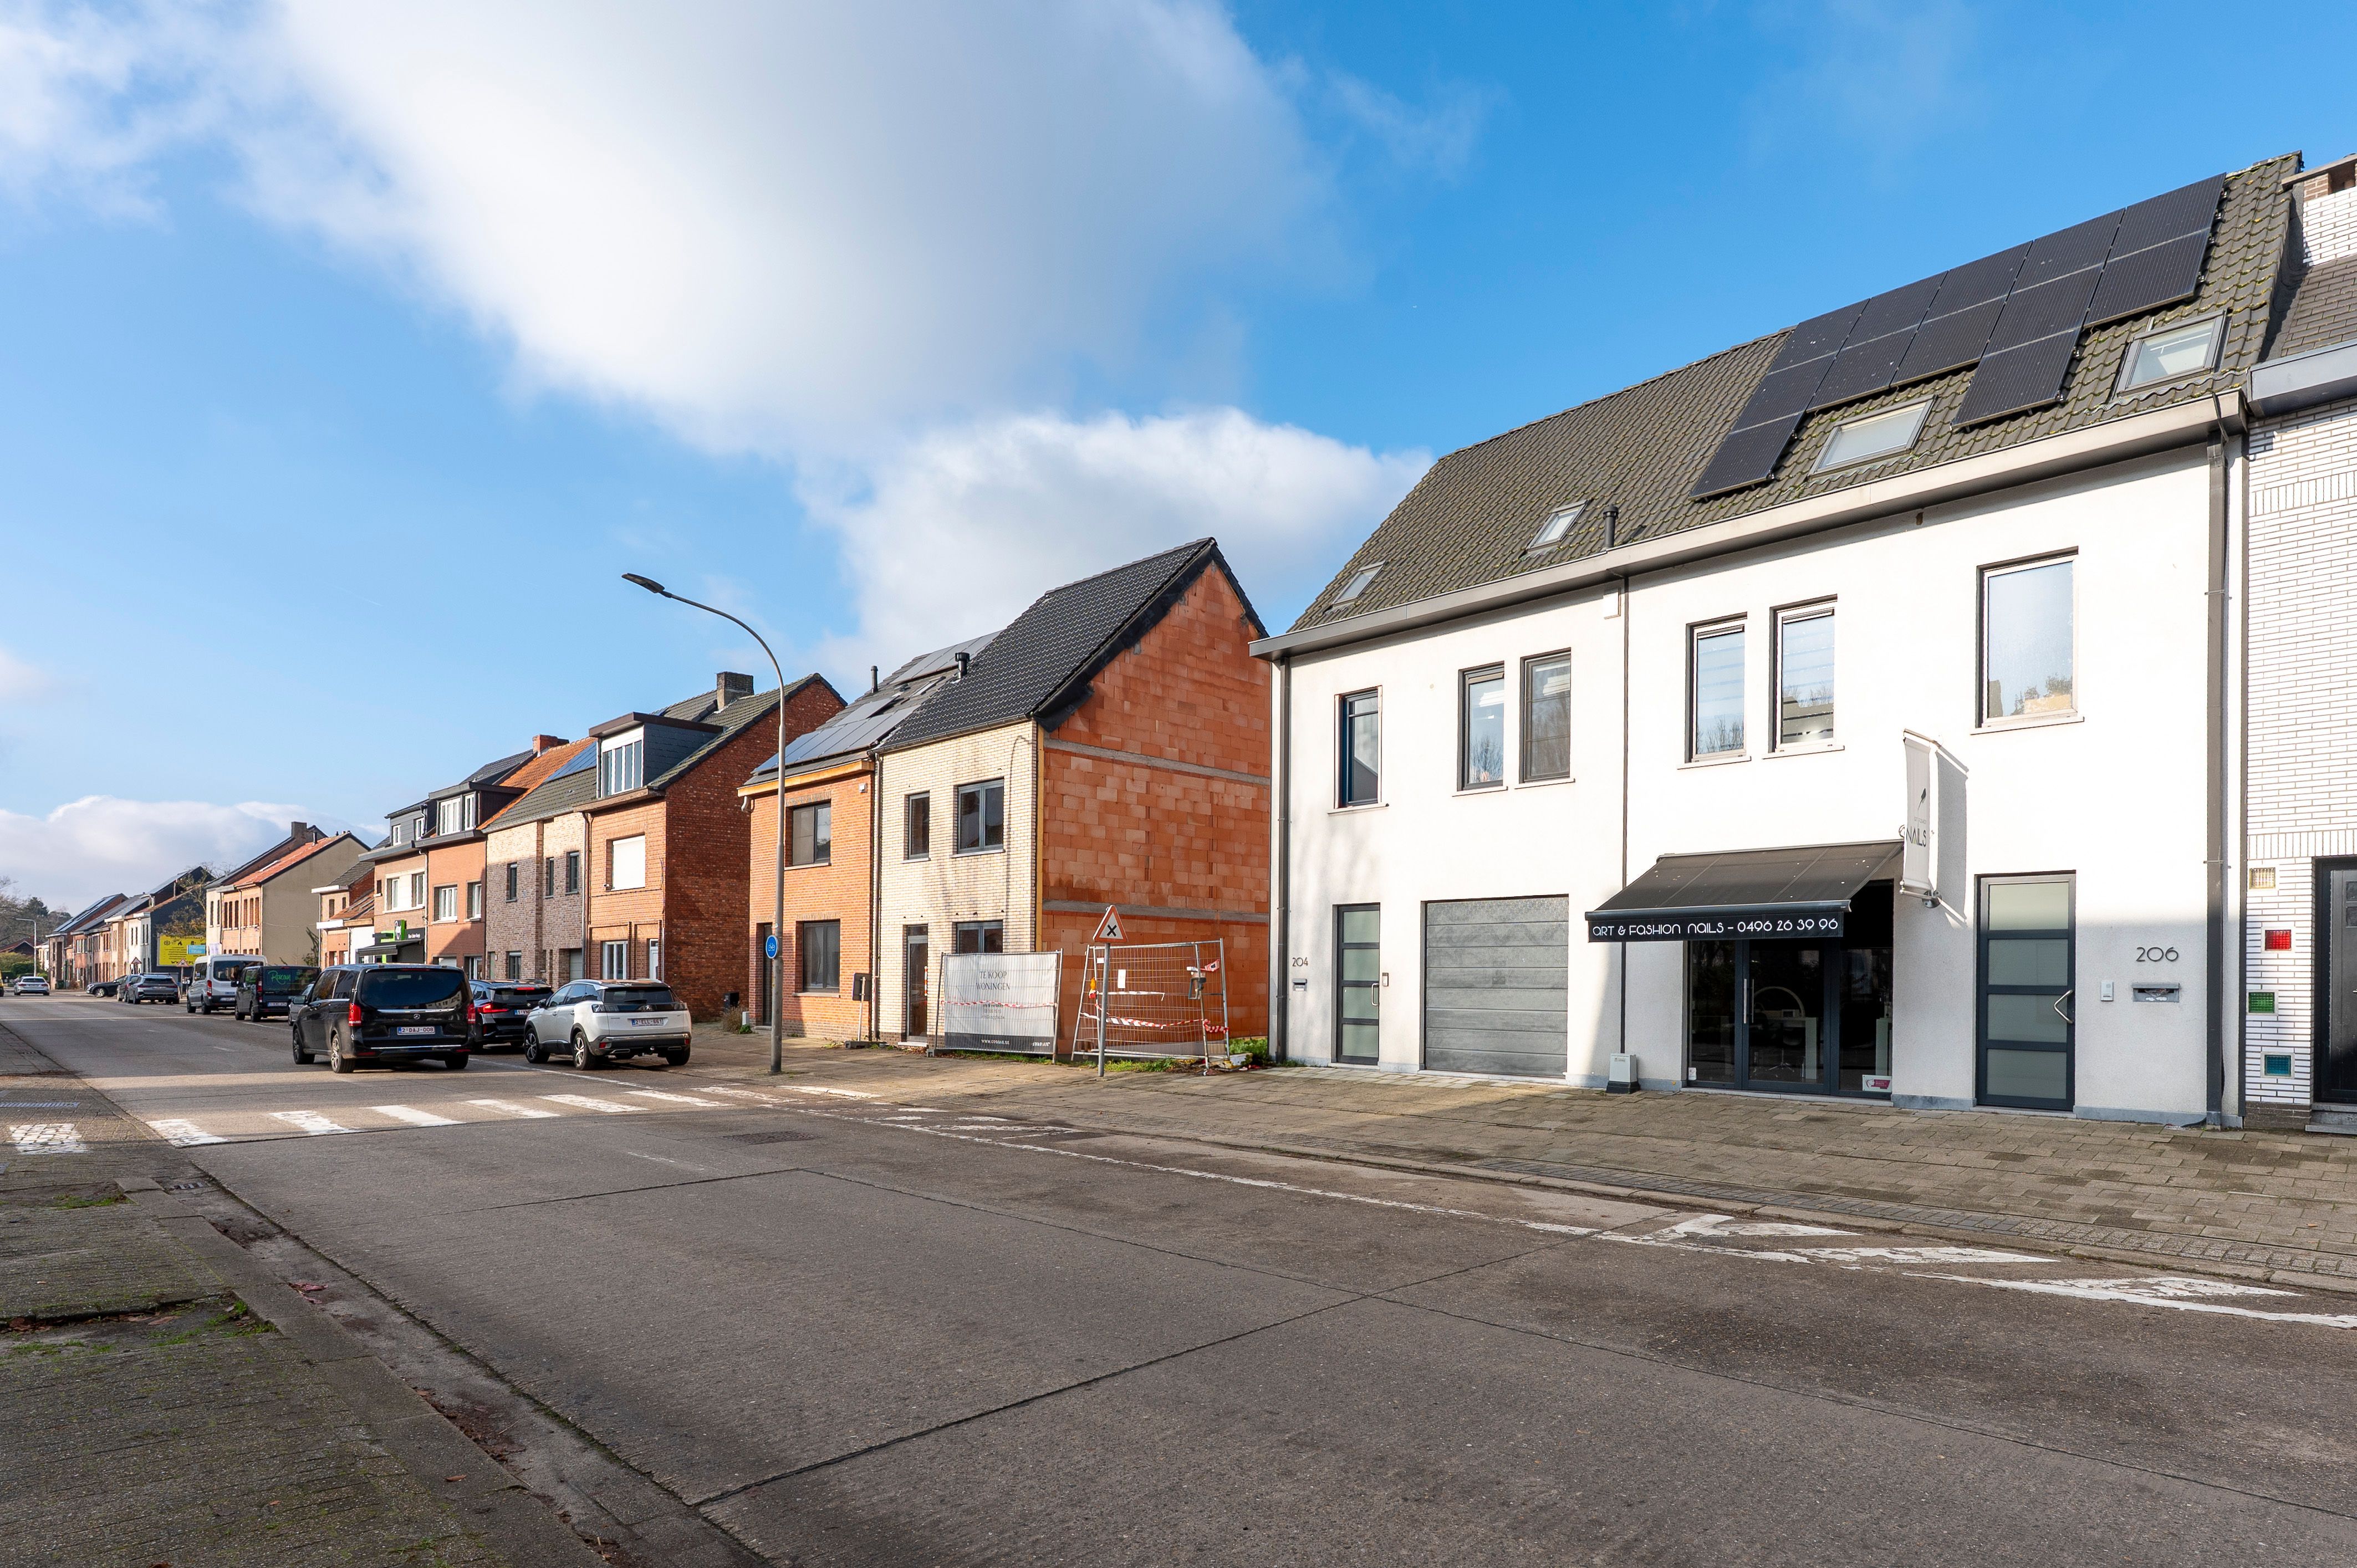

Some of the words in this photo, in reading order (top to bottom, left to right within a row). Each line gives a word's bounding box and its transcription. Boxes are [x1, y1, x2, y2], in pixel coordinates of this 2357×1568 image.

[1906, 826, 1927, 847] NAILS
[1618, 925, 1626, 936] &
[1629, 924, 1681, 936] FASHION
[1687, 922, 1724, 934] NAILS
[1737, 920, 1773, 932] 0496
[1776, 920, 1793, 931] 26
[1797, 918, 1815, 931] 39
[1818, 918, 1839, 930] 96
[2136, 947, 2179, 962] 206
[1292, 957, 1309, 967] 204
[979, 971, 987, 979] TE
[988, 971, 1007, 979] KOOP
[976, 982, 1011, 990] WONINGEN
